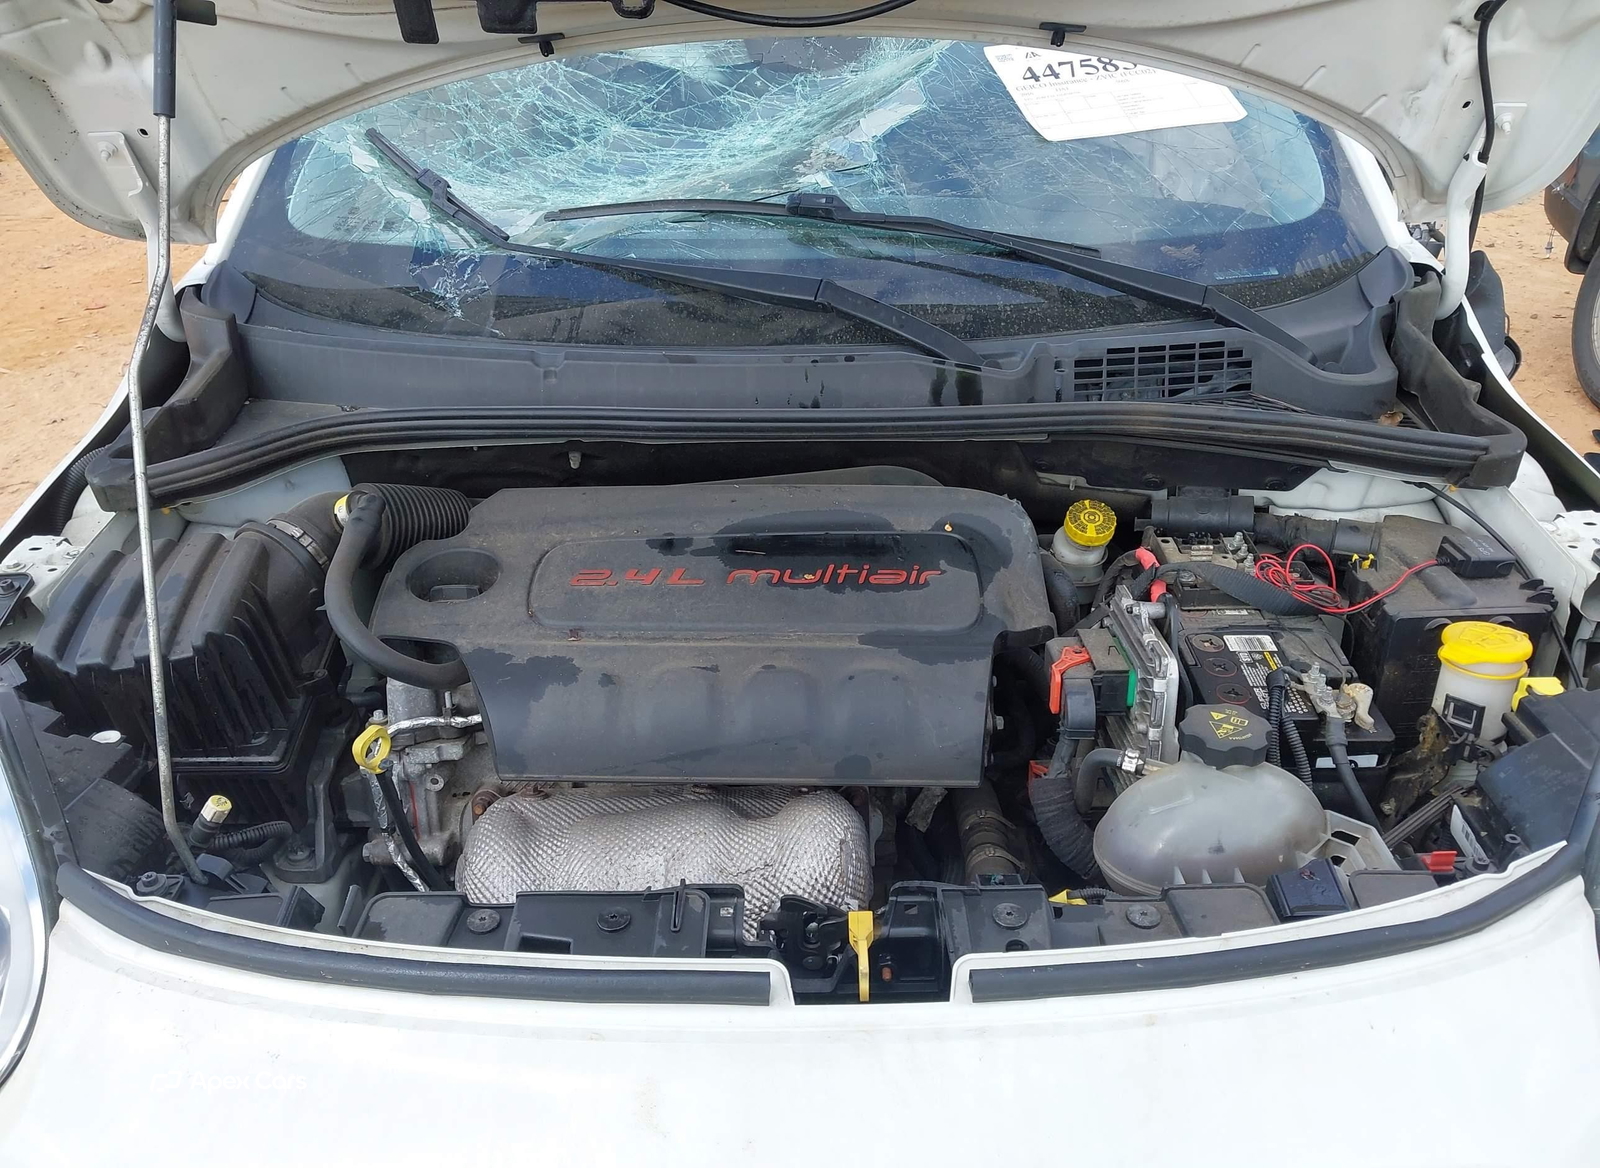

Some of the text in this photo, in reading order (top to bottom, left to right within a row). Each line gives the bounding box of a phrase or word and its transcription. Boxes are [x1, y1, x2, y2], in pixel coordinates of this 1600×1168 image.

[1016, 83, 1047, 92] GEICO
[1048, 77, 1088, 88] Insurance
[726, 564, 942, 585] multiair
